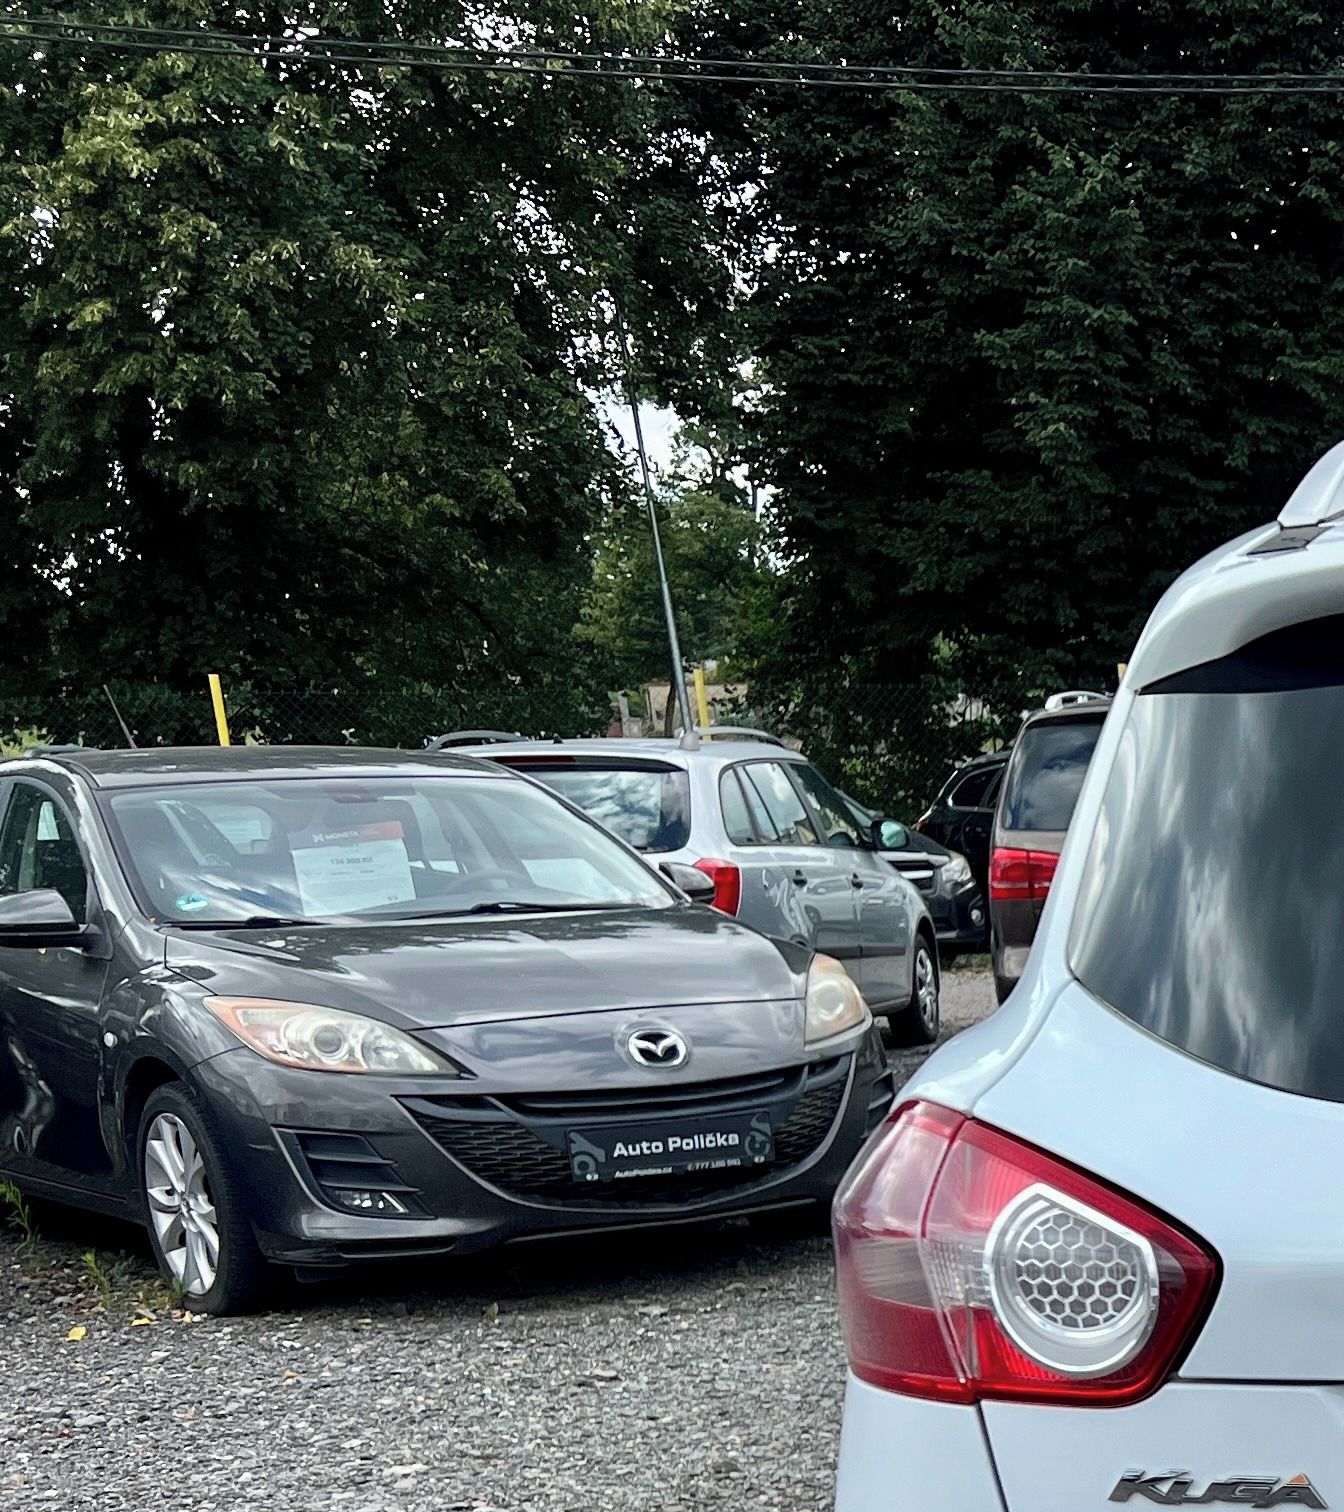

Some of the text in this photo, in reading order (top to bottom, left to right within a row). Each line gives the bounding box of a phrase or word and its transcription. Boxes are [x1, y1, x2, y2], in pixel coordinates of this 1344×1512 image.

[612, 1132, 739, 1158] Auto Polička
[1107, 1468, 1329, 1510] KUGA
